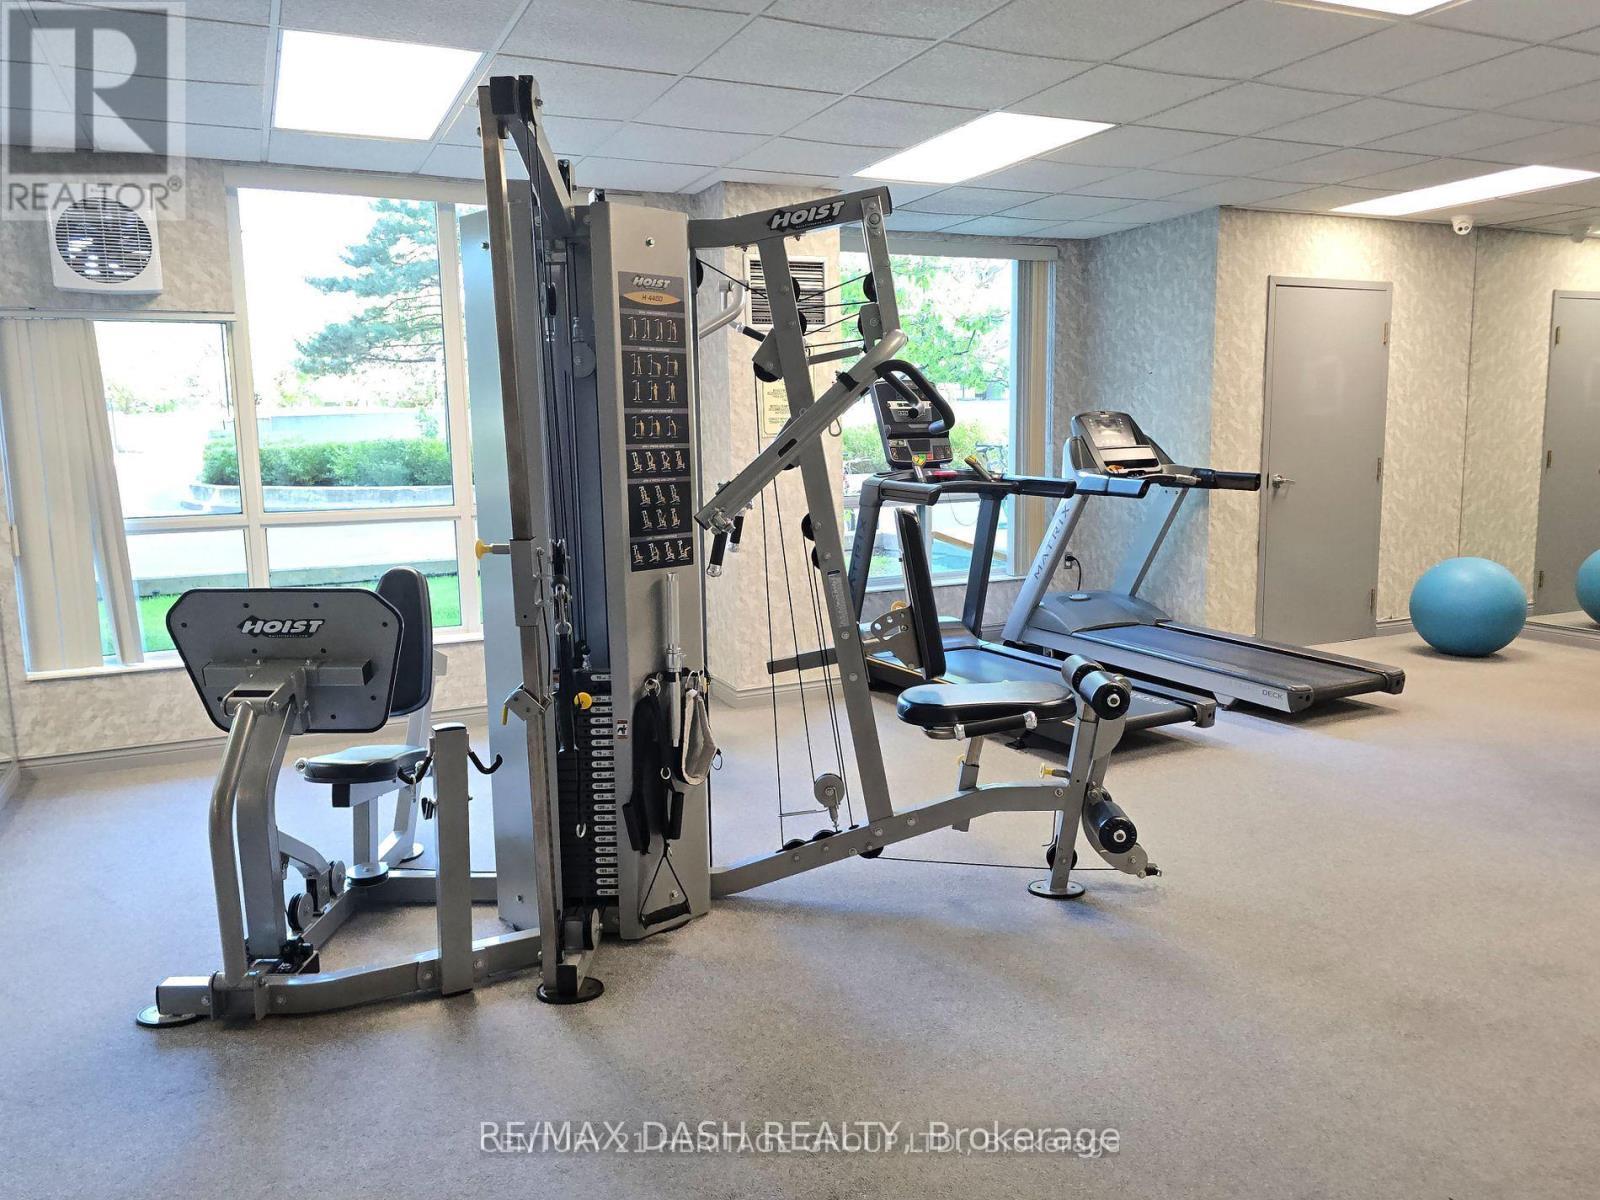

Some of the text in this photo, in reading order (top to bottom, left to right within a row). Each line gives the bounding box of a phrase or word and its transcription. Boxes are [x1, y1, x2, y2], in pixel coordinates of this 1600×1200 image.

[770, 201, 845, 230] HOIST
[632, 275, 671, 289] HOIST
[1034, 505, 1070, 581] MATRIX
[241, 619, 324, 634] HOIST
[1262, 689, 1284, 700] DECK
